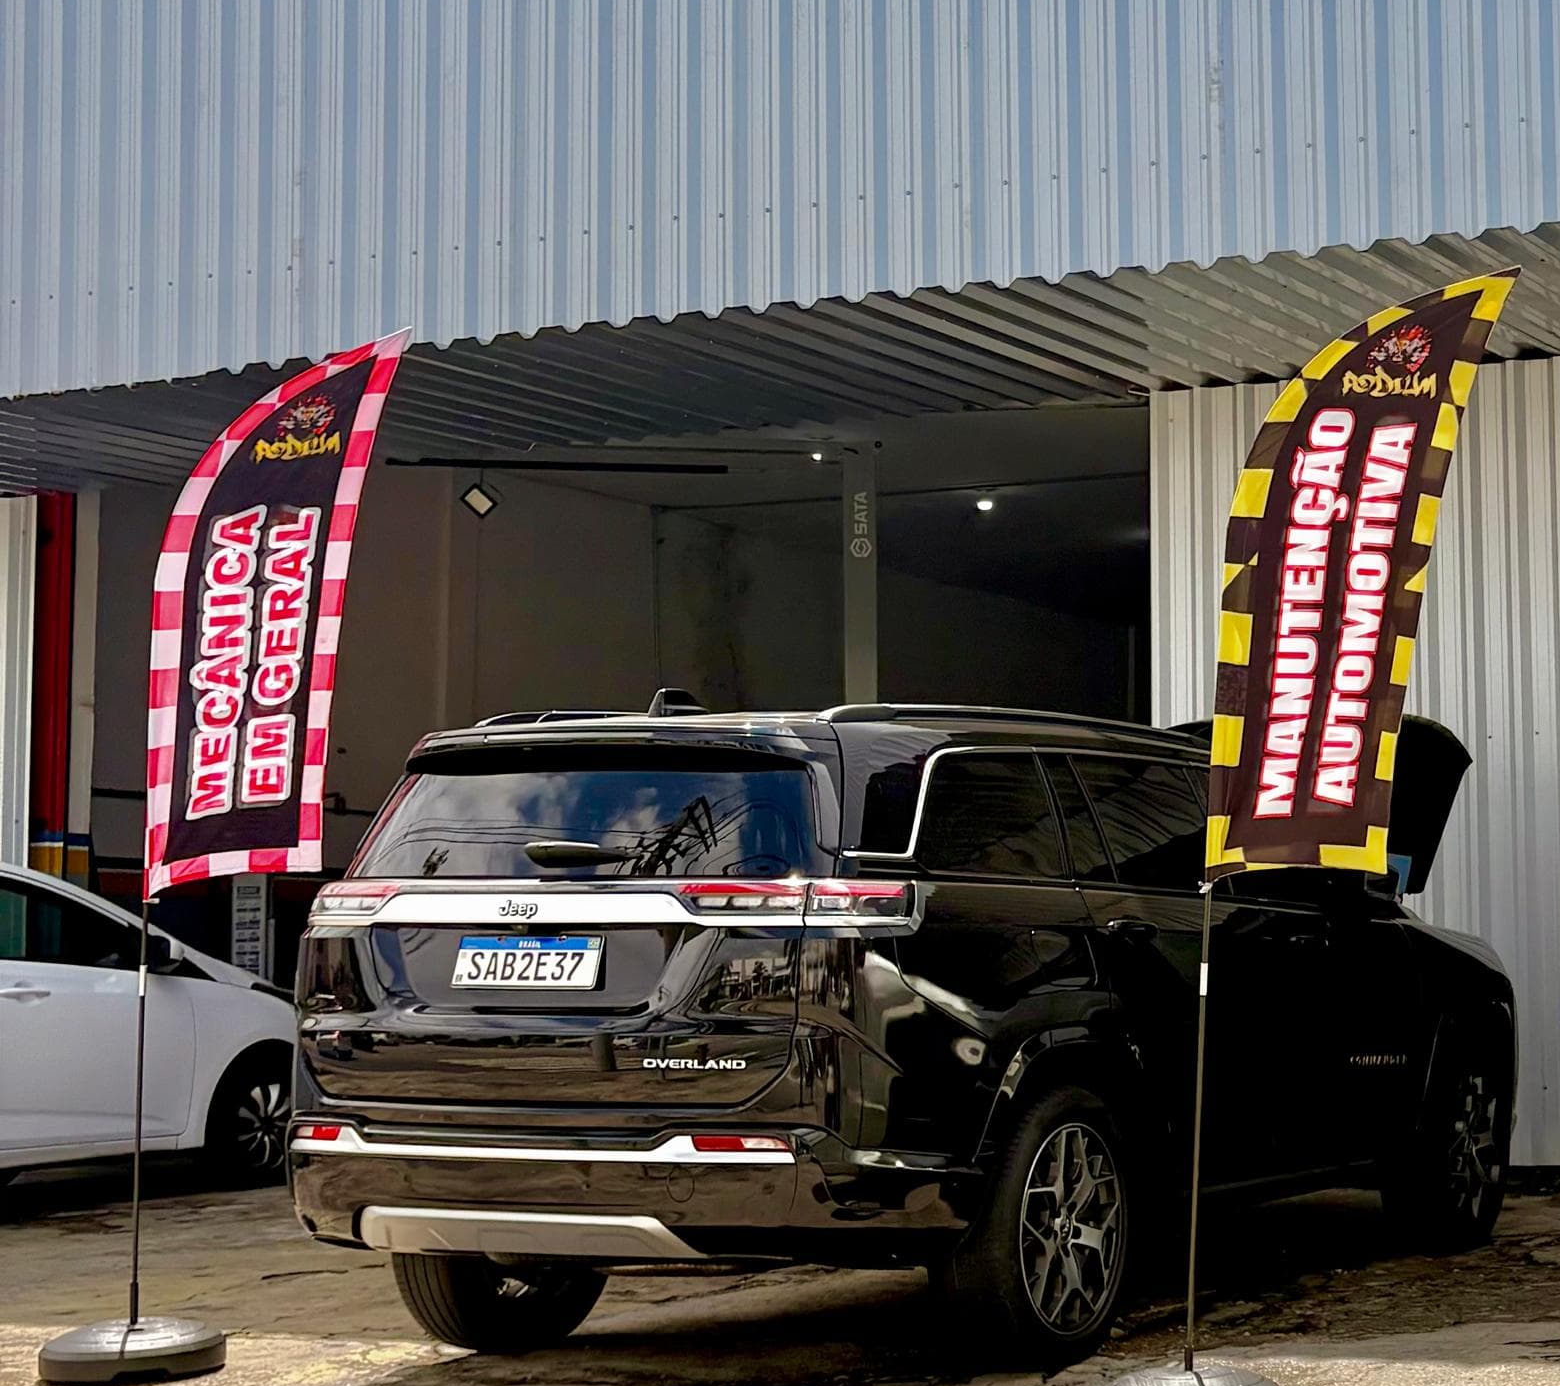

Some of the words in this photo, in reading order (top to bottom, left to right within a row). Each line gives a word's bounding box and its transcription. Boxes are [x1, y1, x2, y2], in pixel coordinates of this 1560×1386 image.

[1342, 365, 1437, 398] PODIUM
[854, 492, 868, 535] SATA
[251, 507, 321, 706] GERAL
[1253, 408, 1356, 819] MANUTENÇÃO
[1313, 422, 1417, 807] AUTOMOTIVA
[186, 504, 267, 820] MECÂNICA
[241, 714, 296, 803] EM
[499, 900, 538, 919] Jeep
[468, 952, 585, 981] SAB2E37
[643, 1058, 746, 1070] OVERLAND
